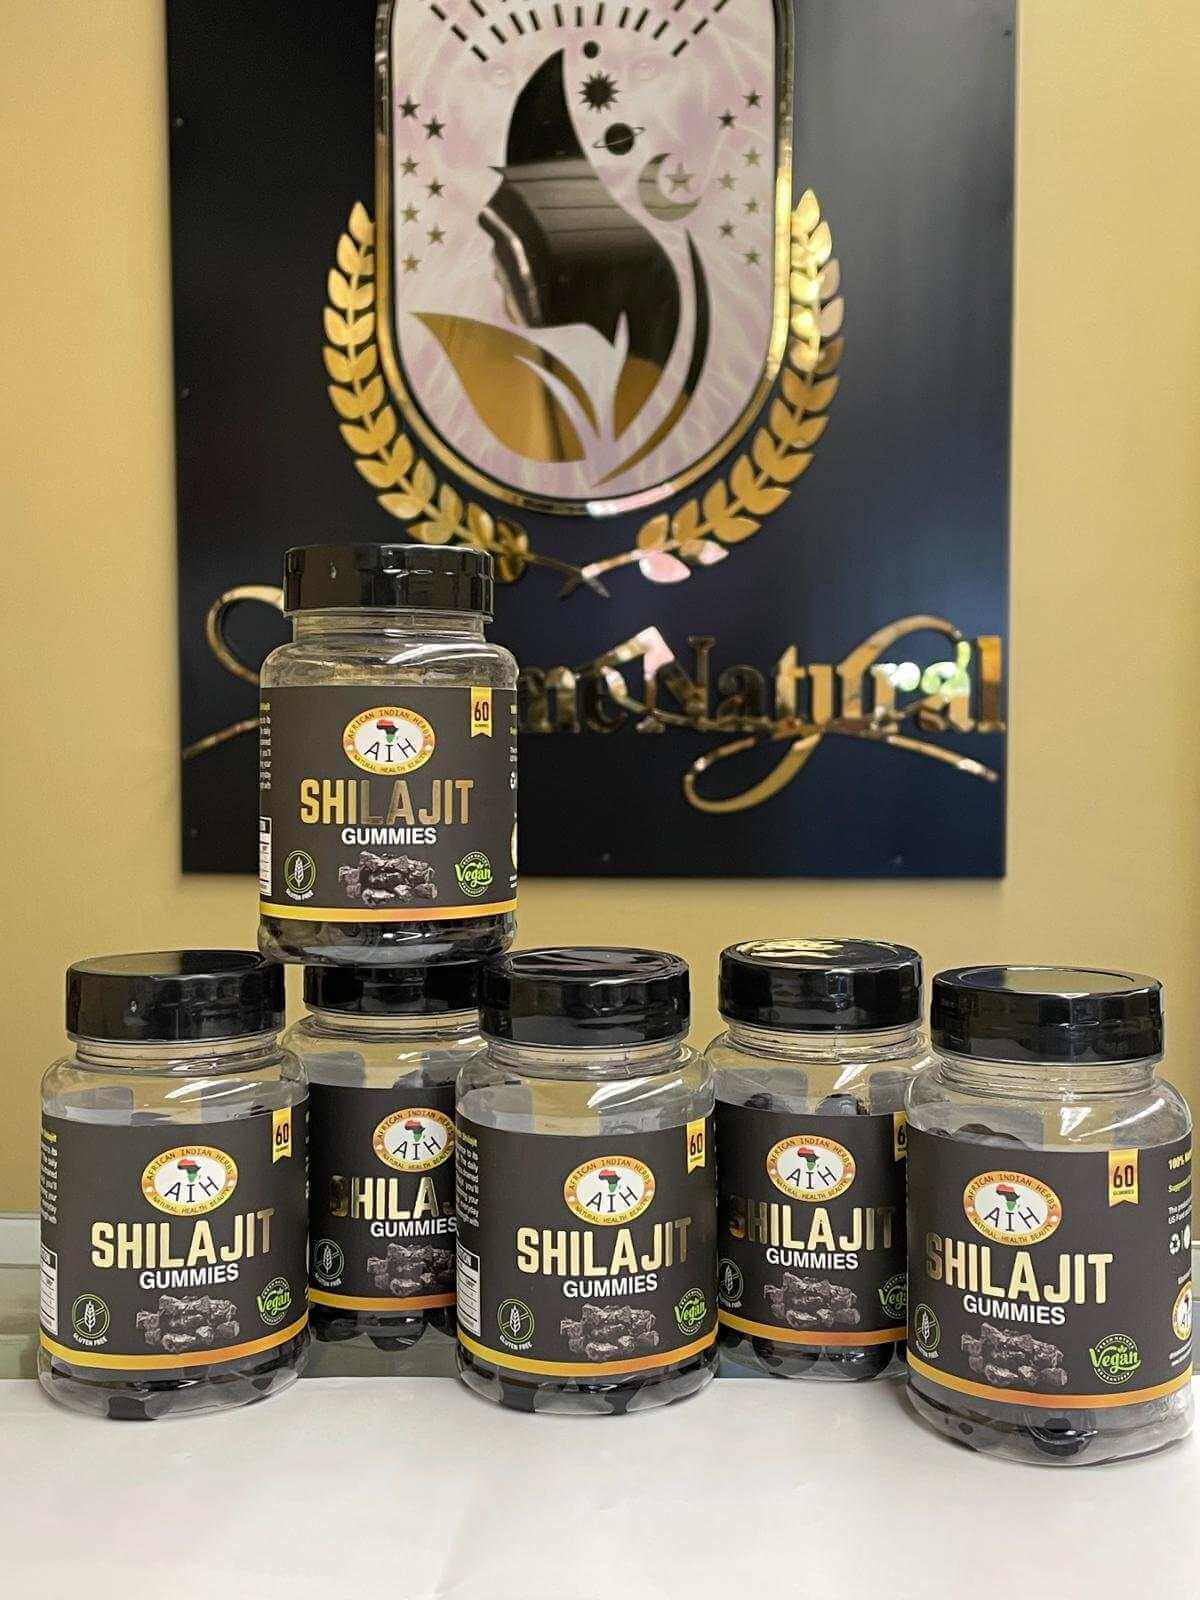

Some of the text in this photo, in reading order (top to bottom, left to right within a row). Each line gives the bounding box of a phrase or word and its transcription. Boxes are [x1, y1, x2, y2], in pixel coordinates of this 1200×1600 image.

[379, 708, 410, 720] INDIAN
[474, 701, 490, 722] 60
[363, 738, 417, 763] AIH
[300, 778, 474, 825] SHILAJIT
[341, 827, 437, 846] GUMMIES
[454, 862, 493, 888] Vegan
[275, 1123, 290, 1146] 60
[690, 1132, 704, 1156] 60
[898, 1125, 907, 1146] 6
[392, 1135, 443, 1161] AIH
[146, 1152, 177, 1181] AFRICAN
[181, 1148, 212, 1158] INDIAN
[568, 1161, 598, 1191] AFRICAN
[601, 1158, 632, 1168] INDIAN
[1112, 1164, 1135, 1189] 60
[164, 1175, 220, 1203] AIH
[786, 1166, 838, 1190] AIH
[329, 1174, 456, 1220] SHILA
[585, 1185, 640, 1213] AIH
[966, 1173, 1058, 1210] AFRICAN INDIAN HERBS
[370, 1216, 457, 1238] GUMMIES
[729, 1196, 895, 1252] SHILAJIT
[983, 1206, 1041, 1232] AIH
[91, 1208, 275, 1269] SHILAJIT
[517, 1217, 692, 1276] SHILAJIT
[766, 1248, 860, 1270] GUMMIES
[925, 1232, 1114, 1305] SHILAJIT
[139, 1263, 240, 1290] GUMMIES
[563, 1272, 658, 1298] GUMMIES
[256, 1290, 292, 1316] Vegan
[674, 1299, 707, 1326] Vegan
[963, 1294, 1067, 1325] GUMMIES
[1088, 1344, 1142, 1374] Vegan
